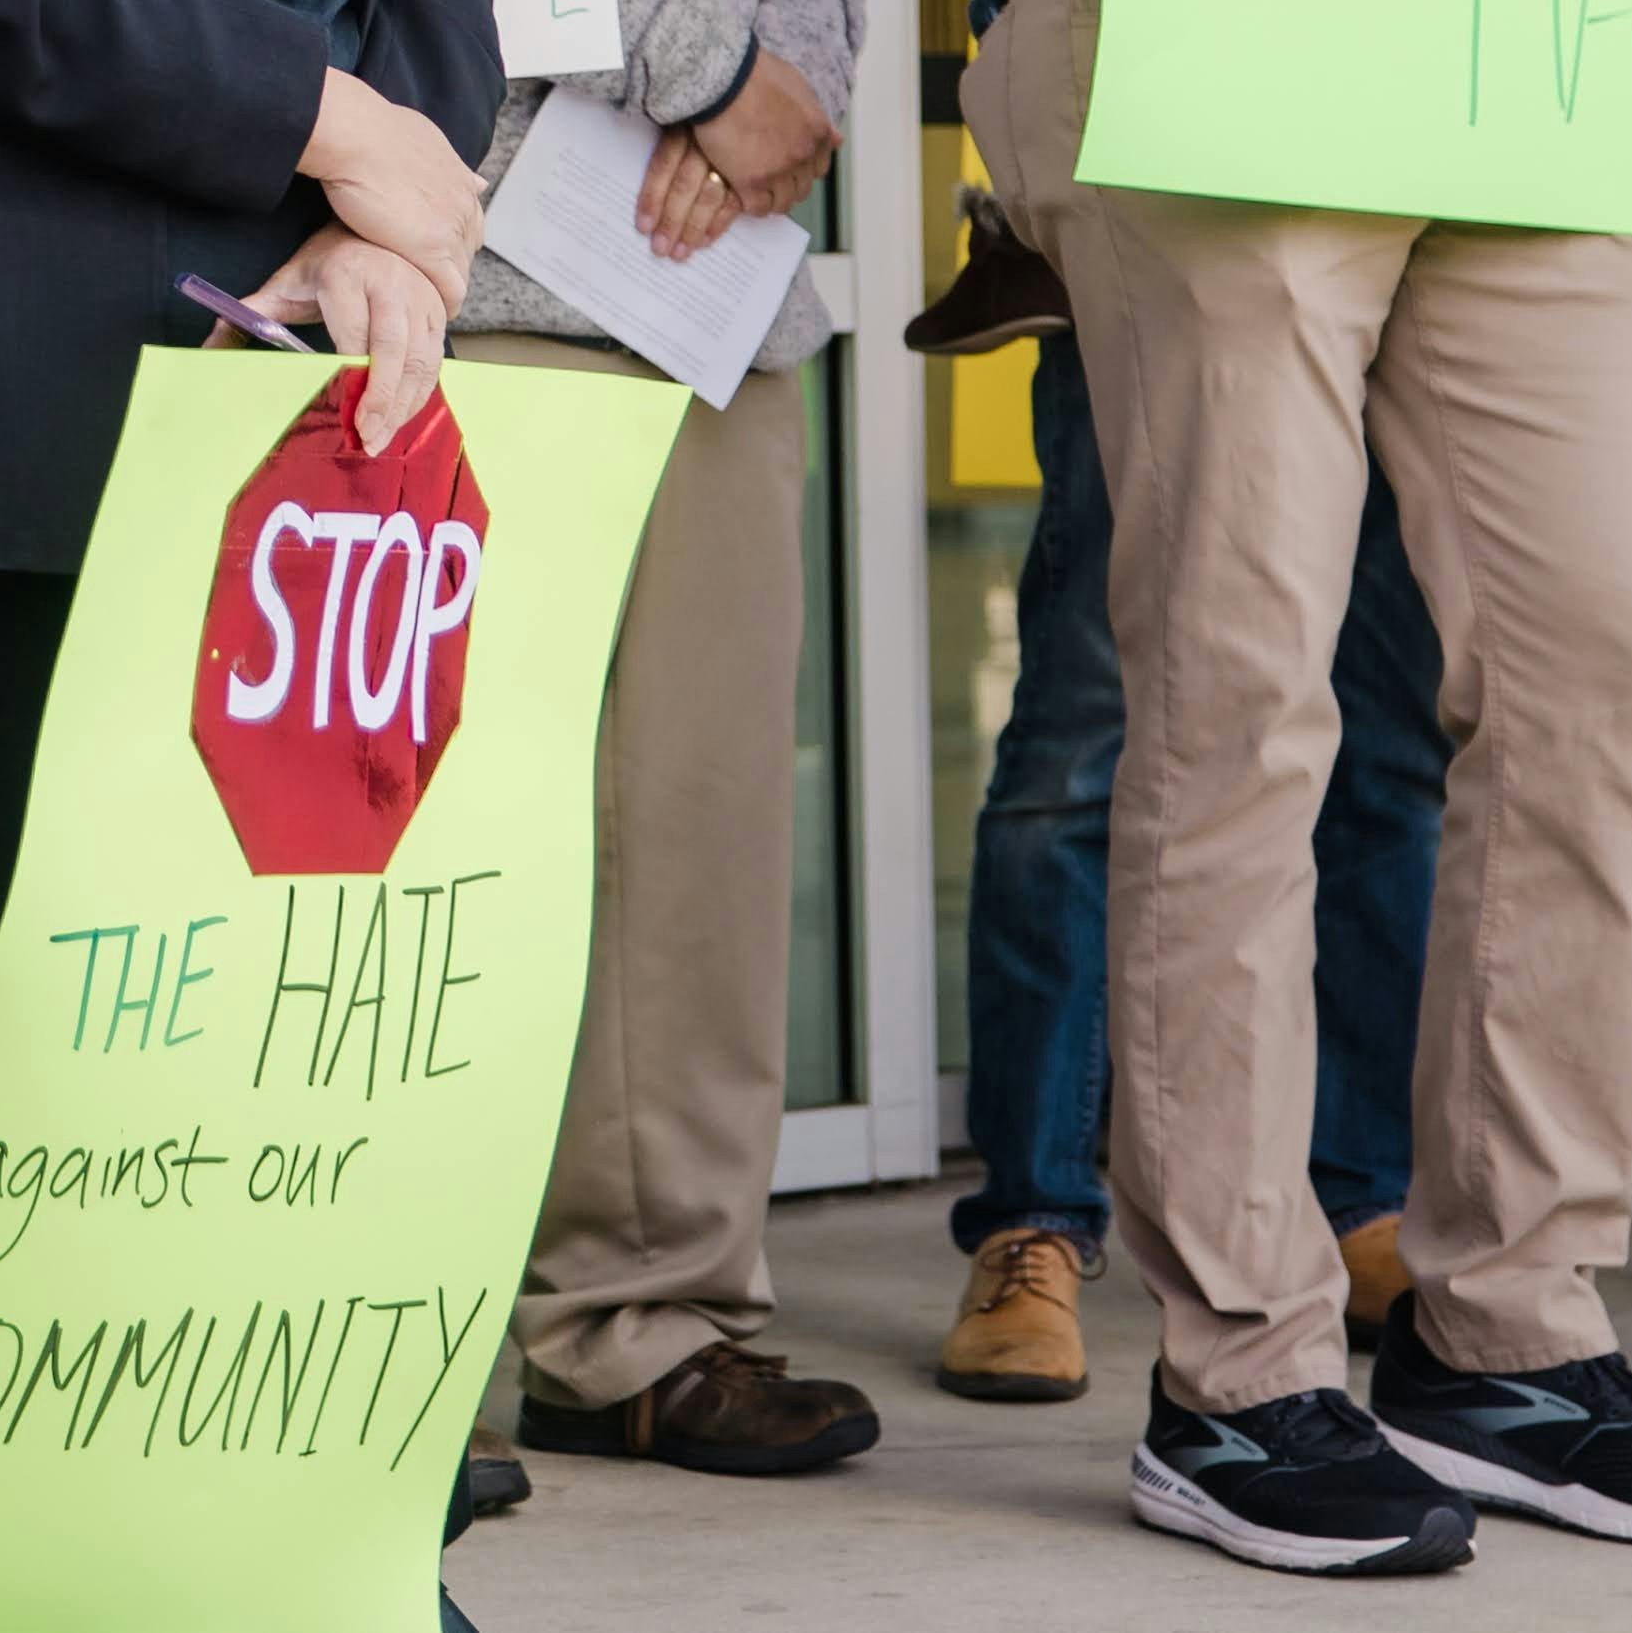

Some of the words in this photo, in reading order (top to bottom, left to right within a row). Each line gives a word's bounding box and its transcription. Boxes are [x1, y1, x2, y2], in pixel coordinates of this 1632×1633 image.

[227, 500, 482, 743] STOP
[49, 915, 229, 1055] THE
[253, 870, 503, 1103] HATE
[248, 1133, 370, 1209] our
